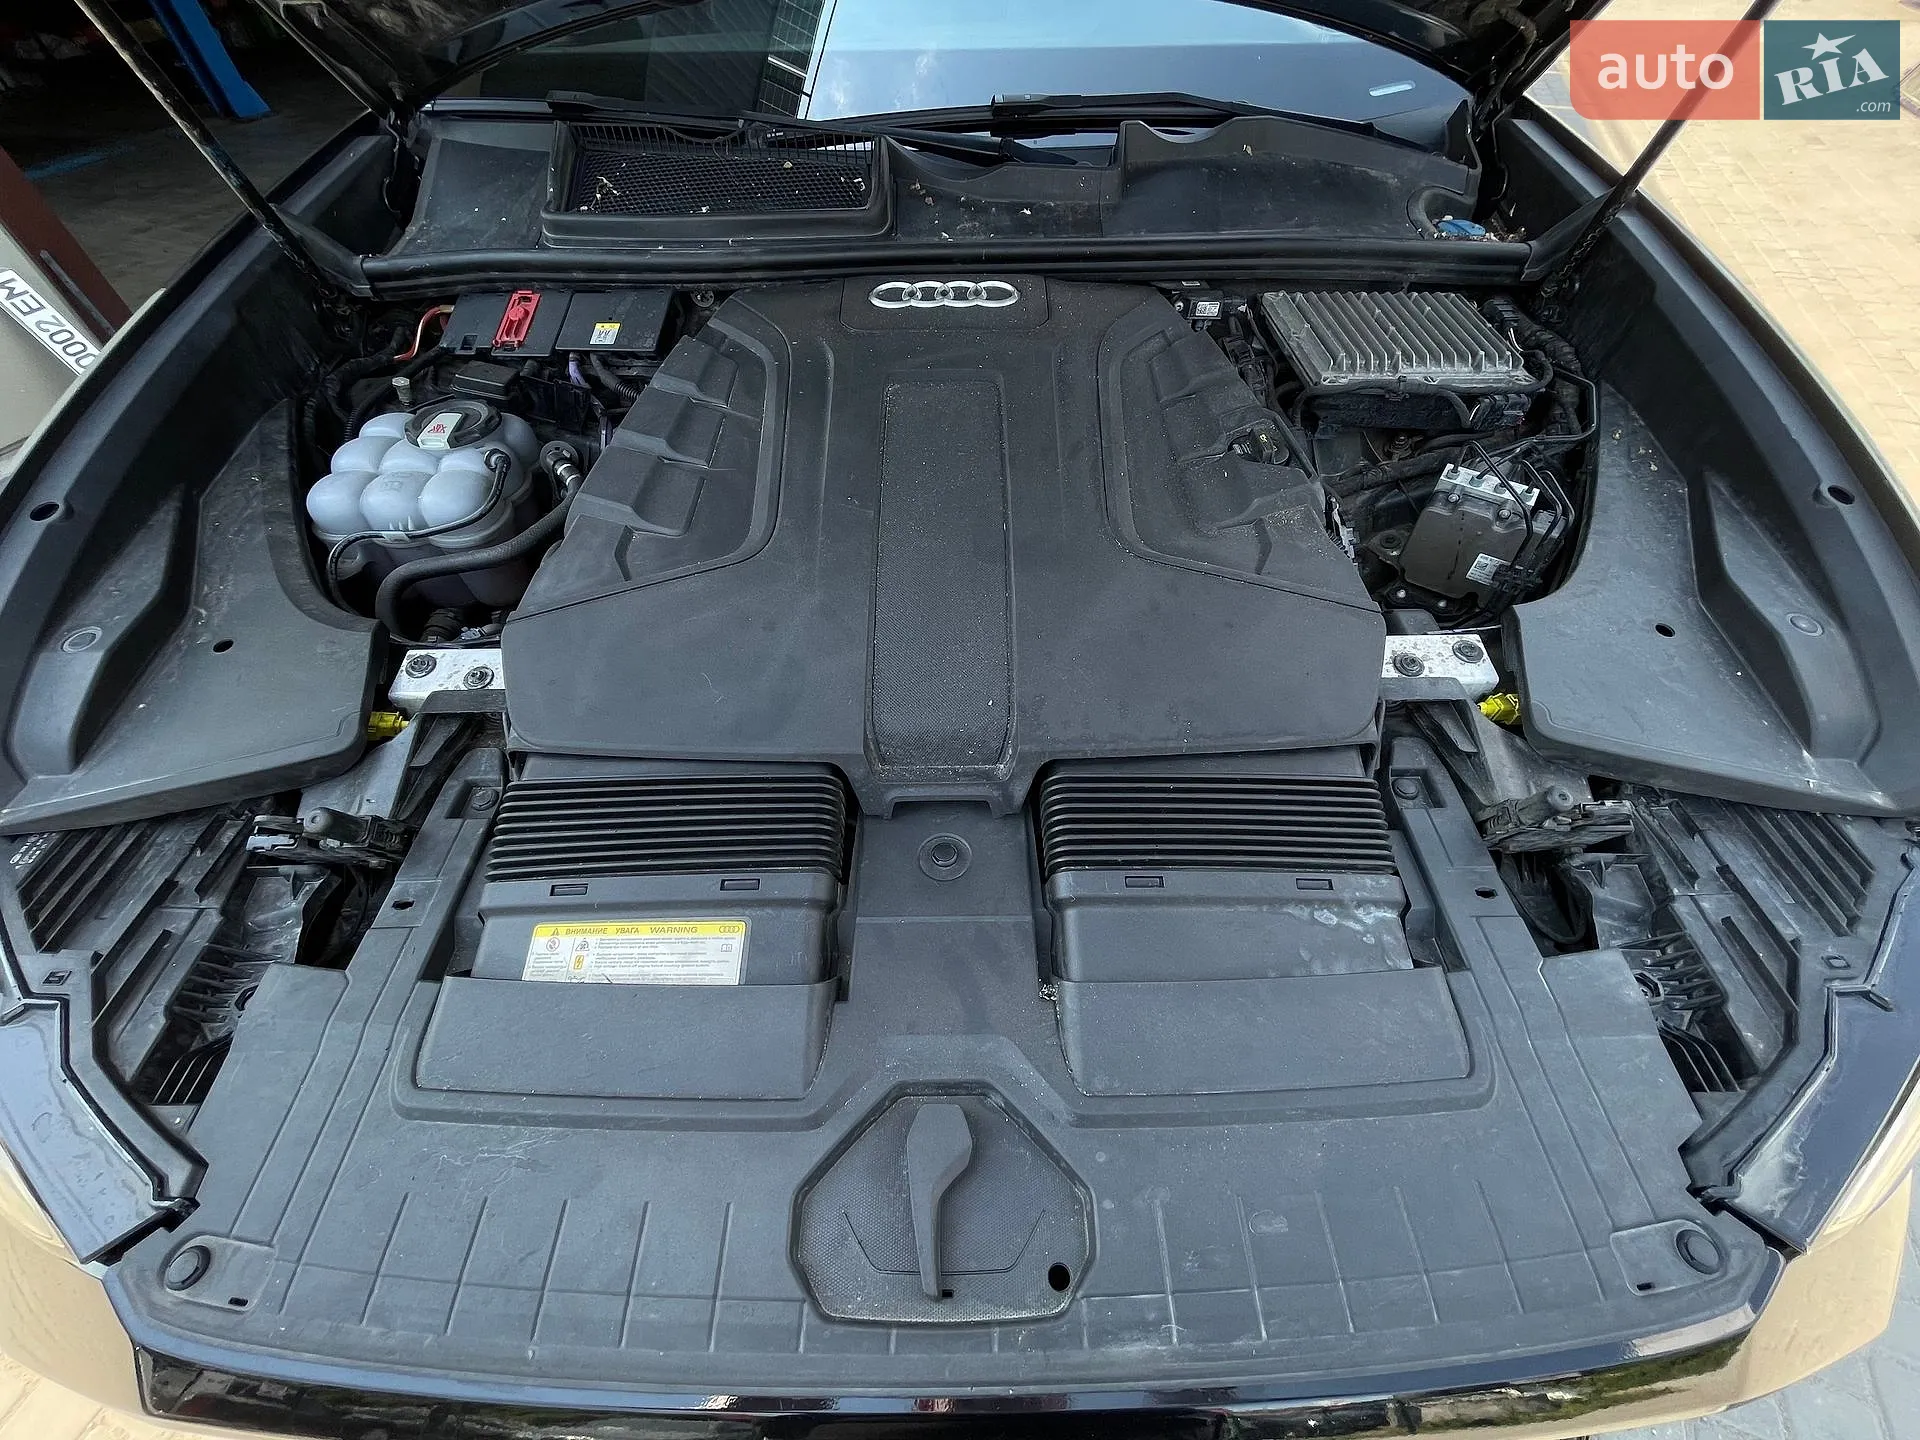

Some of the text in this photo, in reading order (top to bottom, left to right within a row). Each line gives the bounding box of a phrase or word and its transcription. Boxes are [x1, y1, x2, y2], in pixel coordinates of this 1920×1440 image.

[0, 278, 46, 317] EM
[565, 926, 698, 935] ВНИМАНИЕ УВАГА WARNING
